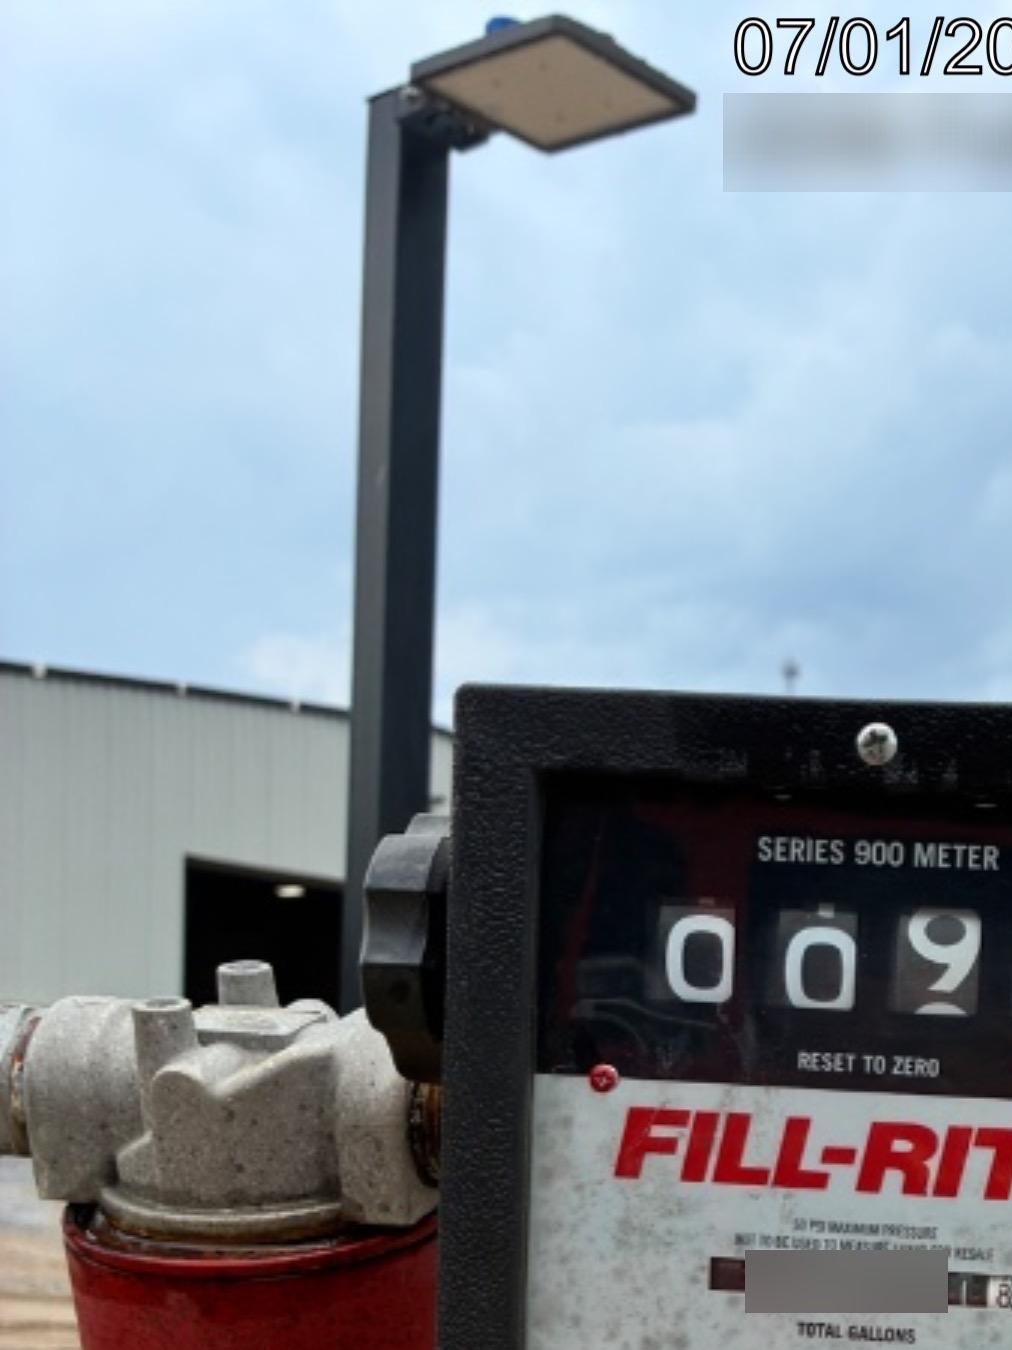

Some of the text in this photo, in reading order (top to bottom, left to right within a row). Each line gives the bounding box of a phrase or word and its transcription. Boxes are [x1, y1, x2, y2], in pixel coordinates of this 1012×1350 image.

[757, 836, 1000, 872] SERIES 900 METER
[798, 1052, 940, 1078] RESET TO ZERO
[881, 1223, 939, 1241] PRESSURE
[797, 1321, 916, 1344] TOTAL GALLONS
